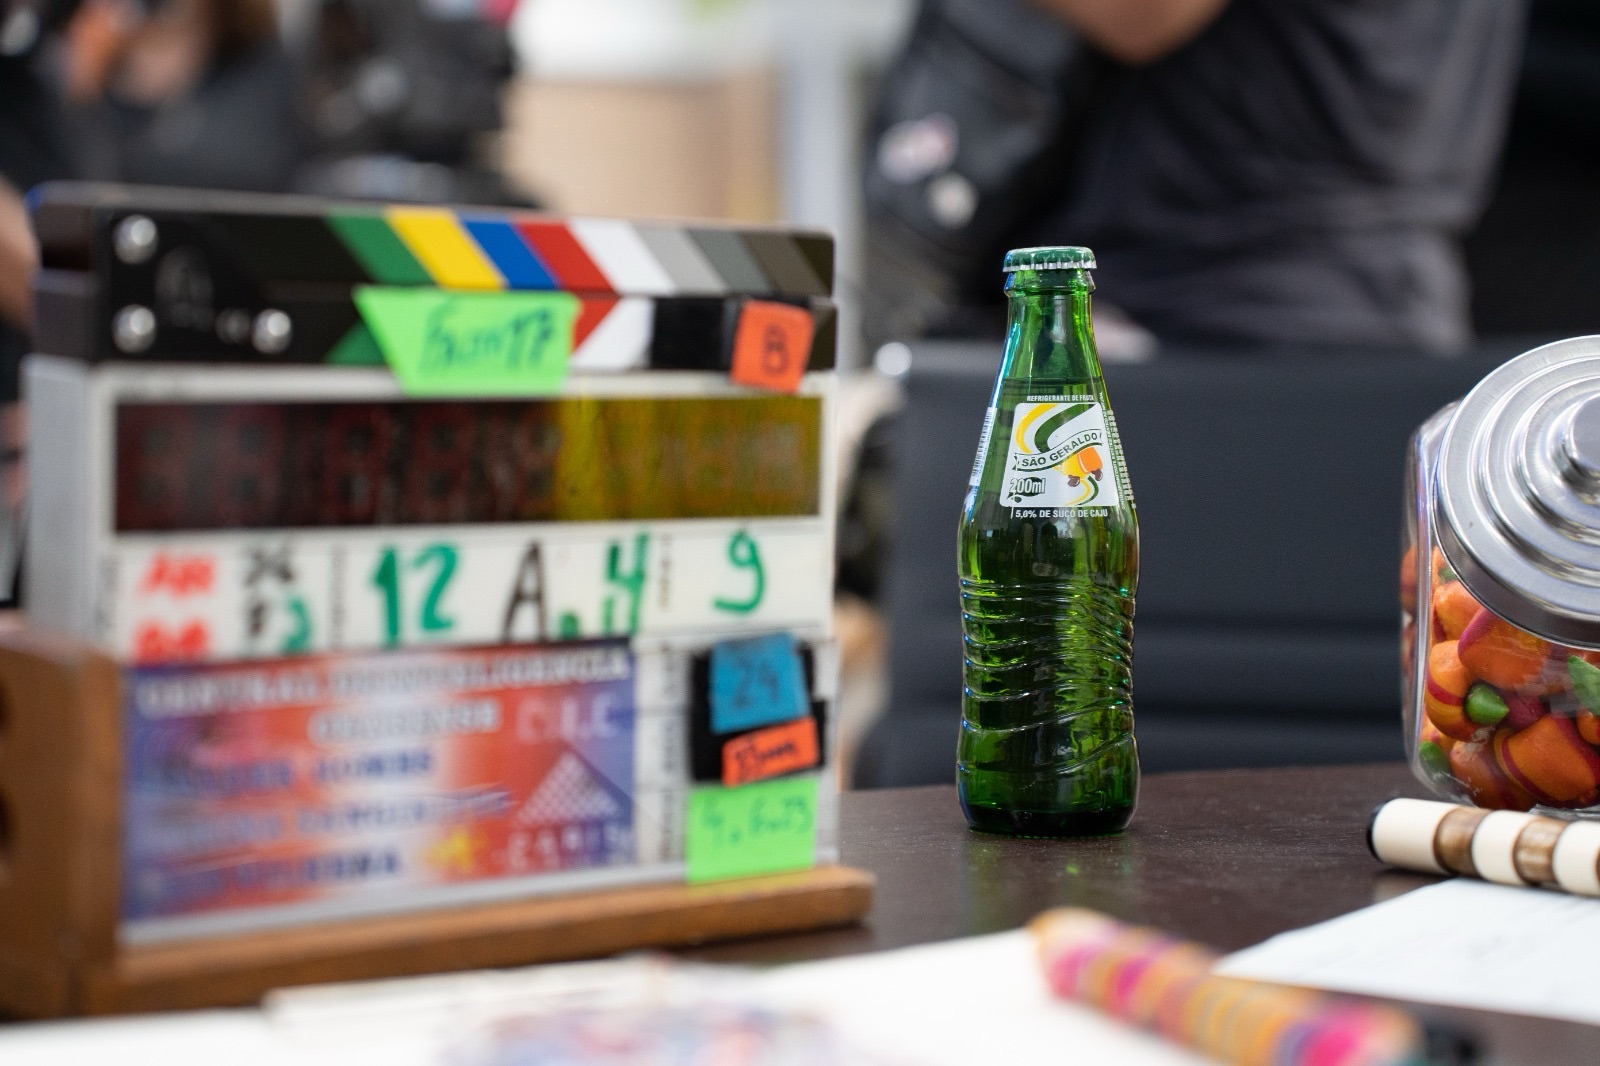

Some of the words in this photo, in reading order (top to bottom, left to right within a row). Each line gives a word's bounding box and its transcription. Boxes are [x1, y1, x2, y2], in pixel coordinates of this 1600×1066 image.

[1021, 456, 1047, 467] SÃO
[1049, 432, 1098, 462] GERALDO
[1009, 478, 1046, 494] 200ml
[1015, 510, 1037, 518] 5,0%
[1039, 510, 1051, 518] DE
[1052, 510, 1076, 518] SUCO
[1078, 510, 1088, 518] DE
[712, 531, 764, 612] 9
[372, 543, 459, 647] 12
